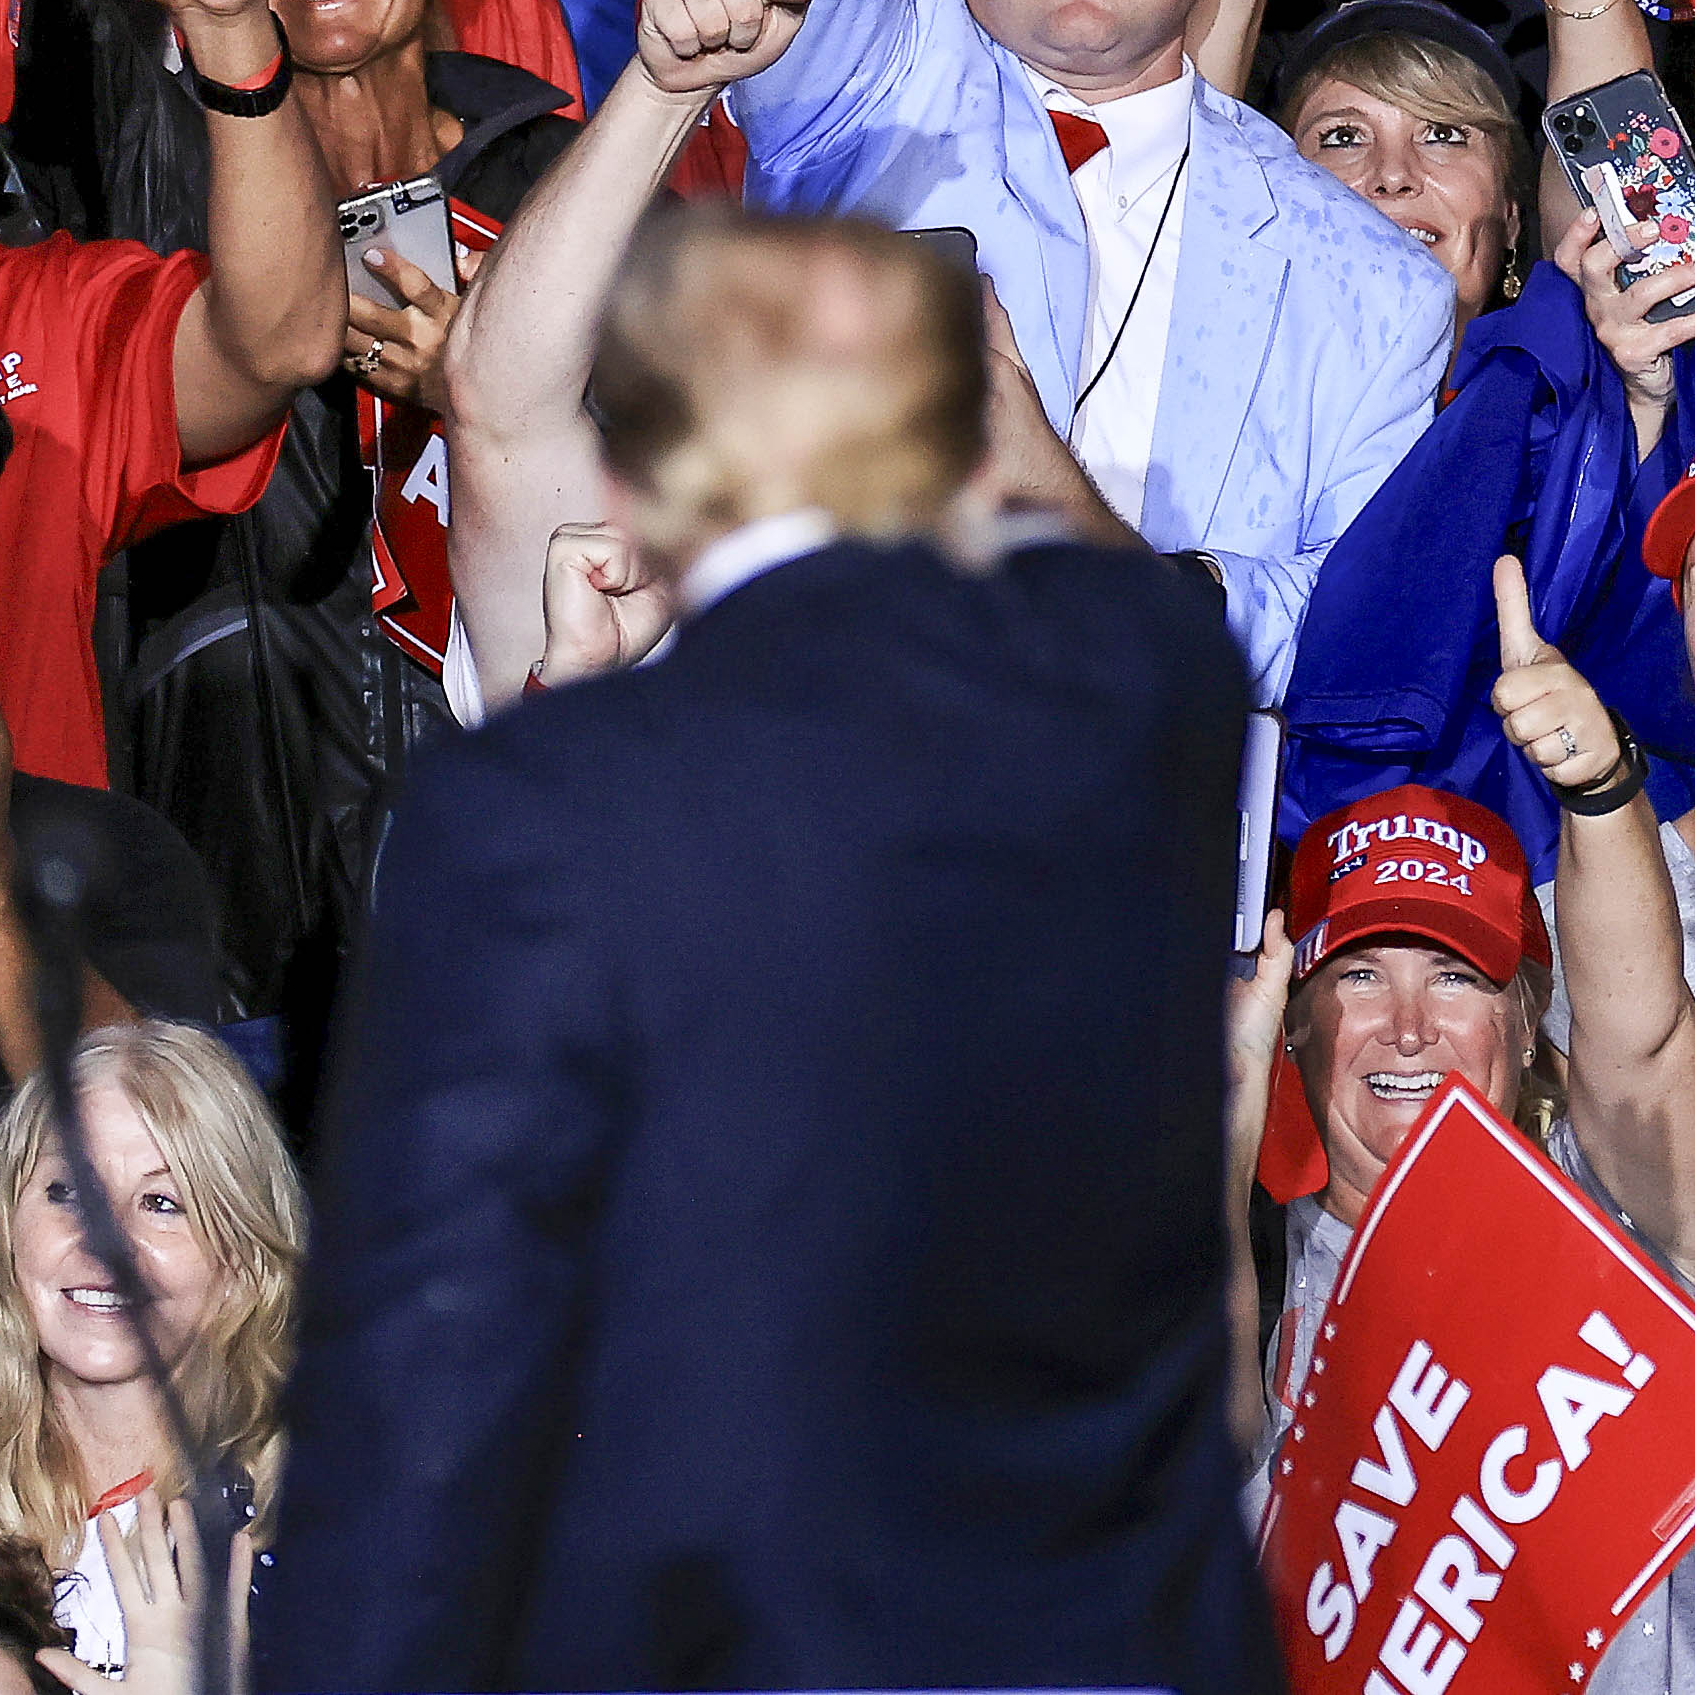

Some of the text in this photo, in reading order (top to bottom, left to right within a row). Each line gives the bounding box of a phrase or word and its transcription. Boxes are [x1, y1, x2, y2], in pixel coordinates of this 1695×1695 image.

[1327, 815, 1488, 871] Trump
[1373, 860, 1473, 896] 2024
[1306, 1339, 1472, 1663] SAVE
[1363, 1309, 1656, 1695] ERICA!
